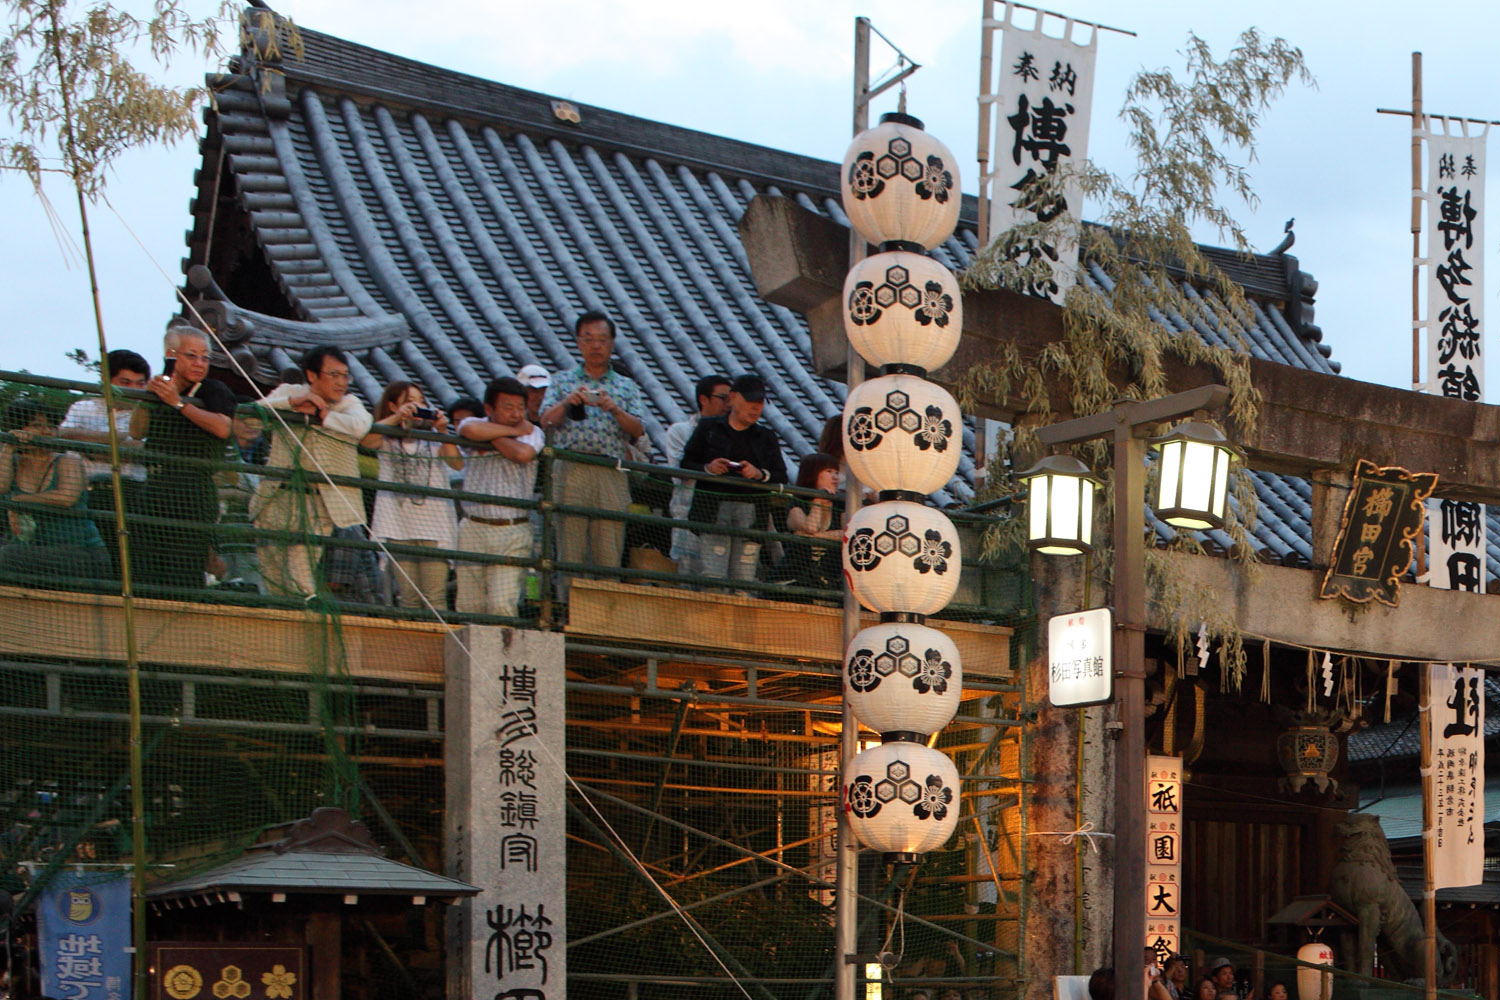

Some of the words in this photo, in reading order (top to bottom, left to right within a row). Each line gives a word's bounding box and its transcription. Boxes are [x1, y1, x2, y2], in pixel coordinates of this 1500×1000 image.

[1013, 51, 1077, 96] 奉納
[1352, 487, 1395, 576] 櫛田宮
